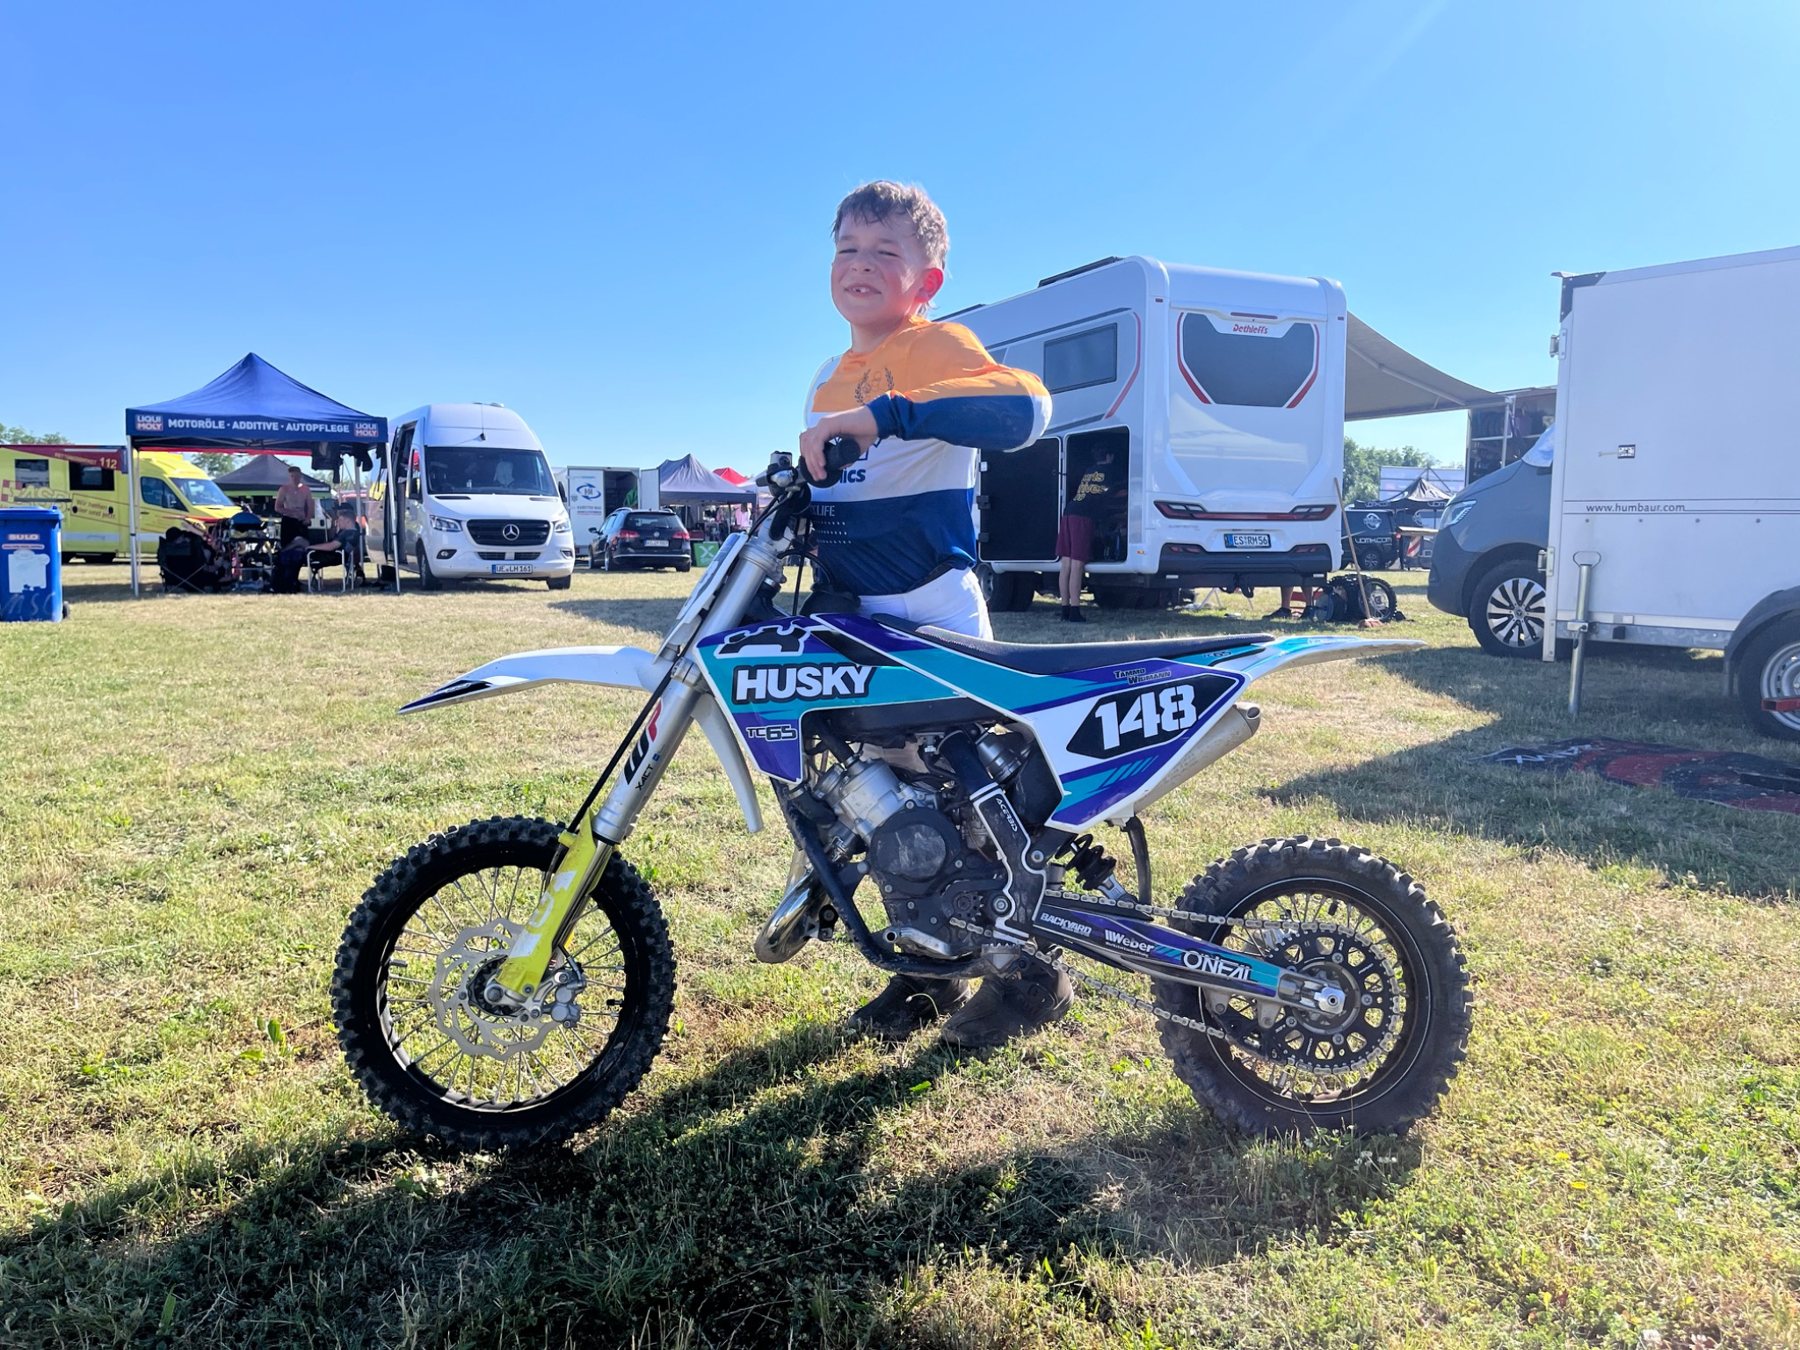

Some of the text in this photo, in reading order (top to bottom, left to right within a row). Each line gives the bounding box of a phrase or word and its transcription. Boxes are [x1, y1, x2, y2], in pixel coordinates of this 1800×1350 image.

[1233, 324, 1268, 334] Dethleffs
[137, 415, 162, 423] LIQUI
[137, 423, 162, 431] MOLY
[168, 418, 350, 433] MOTORÖLE ADDITIVE AUTOPFLEGE
[100, 457, 118, 469] 112
[1586, 503, 1686, 512] www.humbaur.com
[736, 666, 873, 701] HUSKY
[1095, 684, 1198, 750] 148
[746, 724, 798, 742] TC65
[635, 764, 654, 791] XACT
[1040, 912, 1092, 936] BACKYARD
[1108, 931, 1155, 953] Weber
